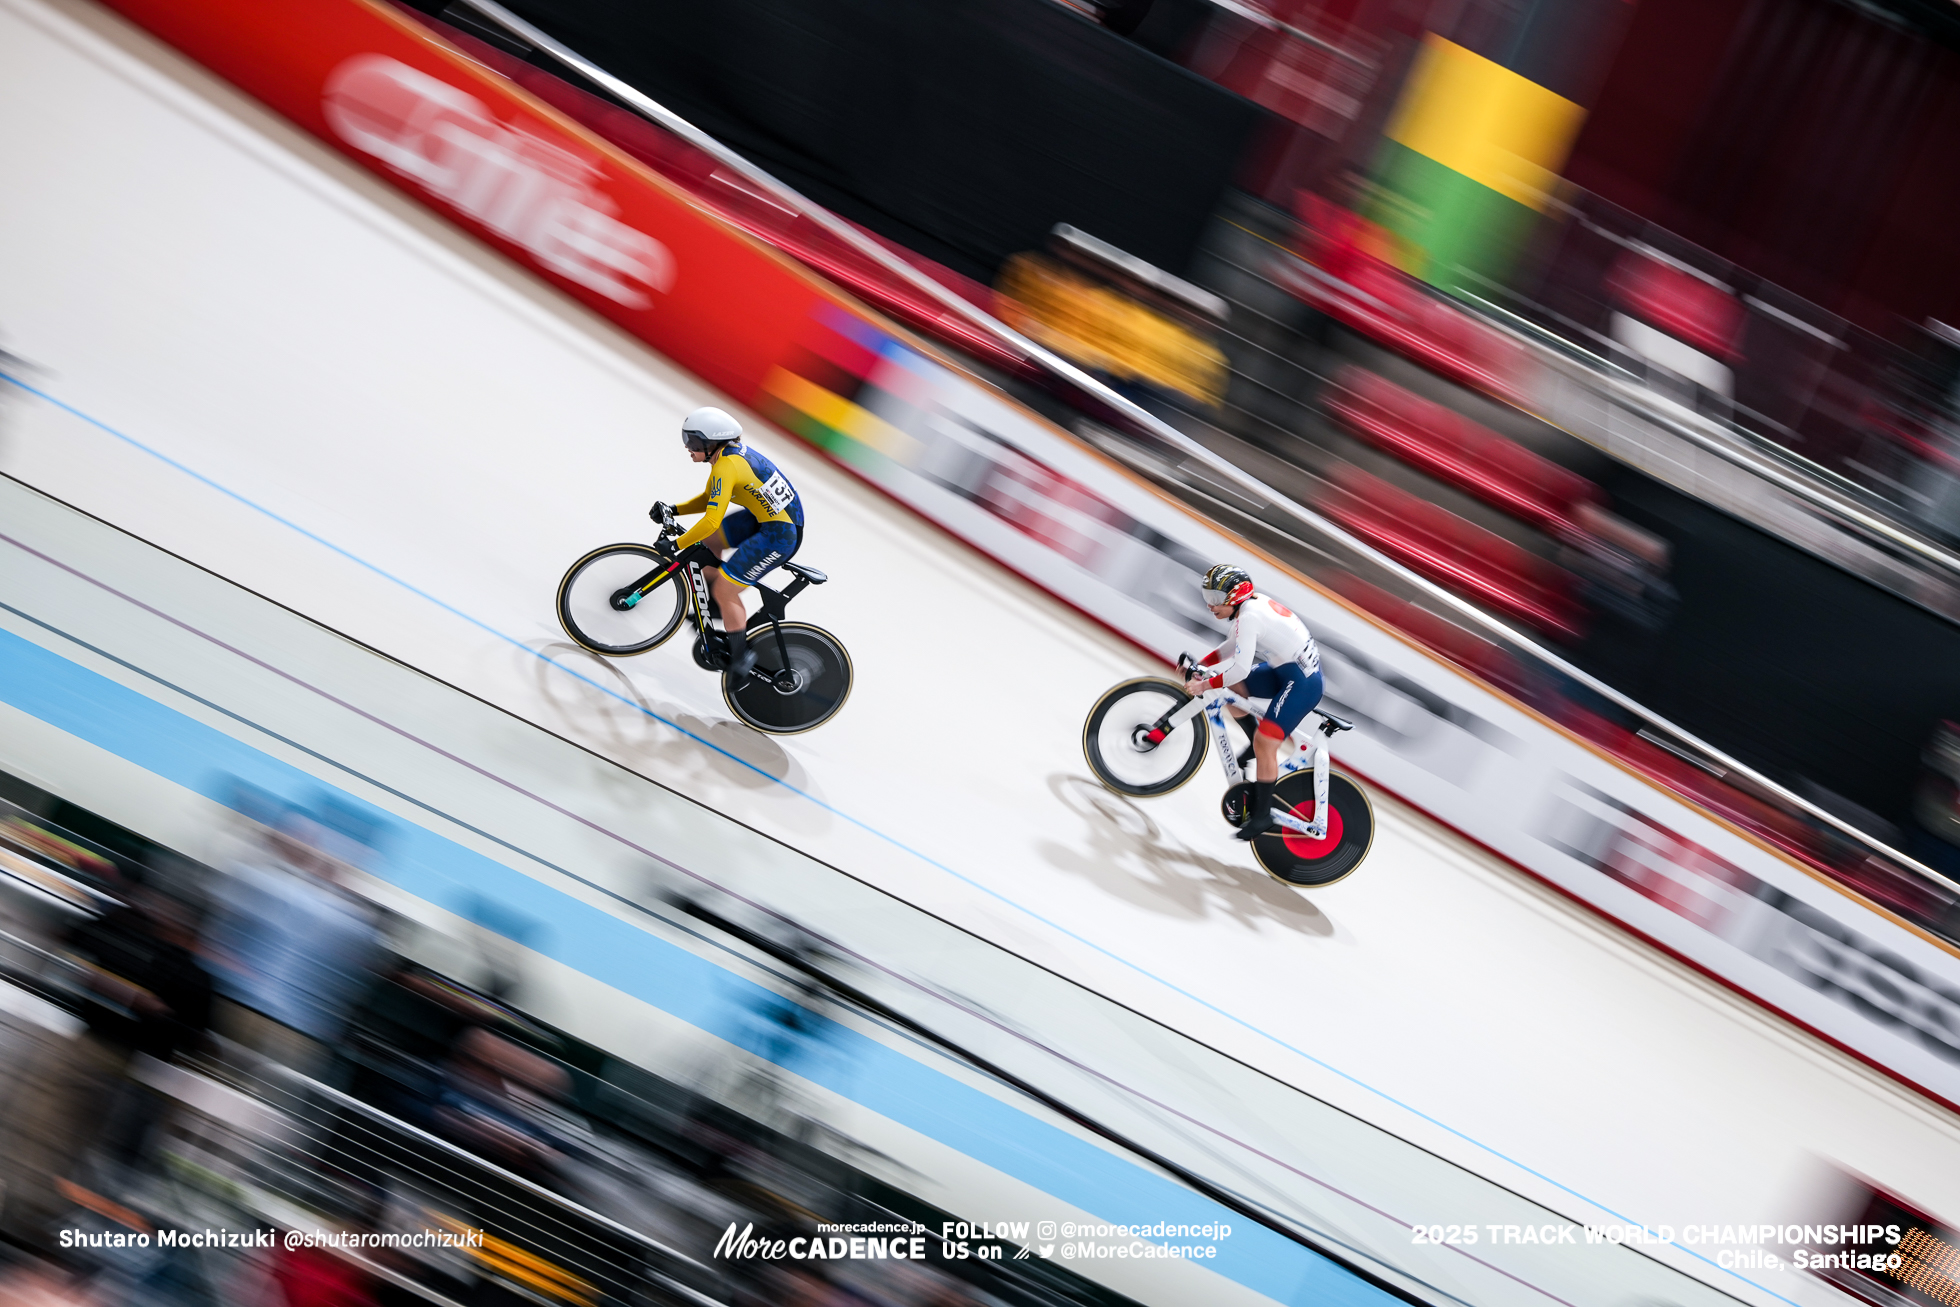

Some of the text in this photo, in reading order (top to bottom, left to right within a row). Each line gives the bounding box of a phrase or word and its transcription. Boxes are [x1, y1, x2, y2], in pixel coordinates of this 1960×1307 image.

[743, 484, 777, 518] UKRAINE
[743, 550, 782, 581] UKRAINE
[689, 561, 715, 629] LOOK
